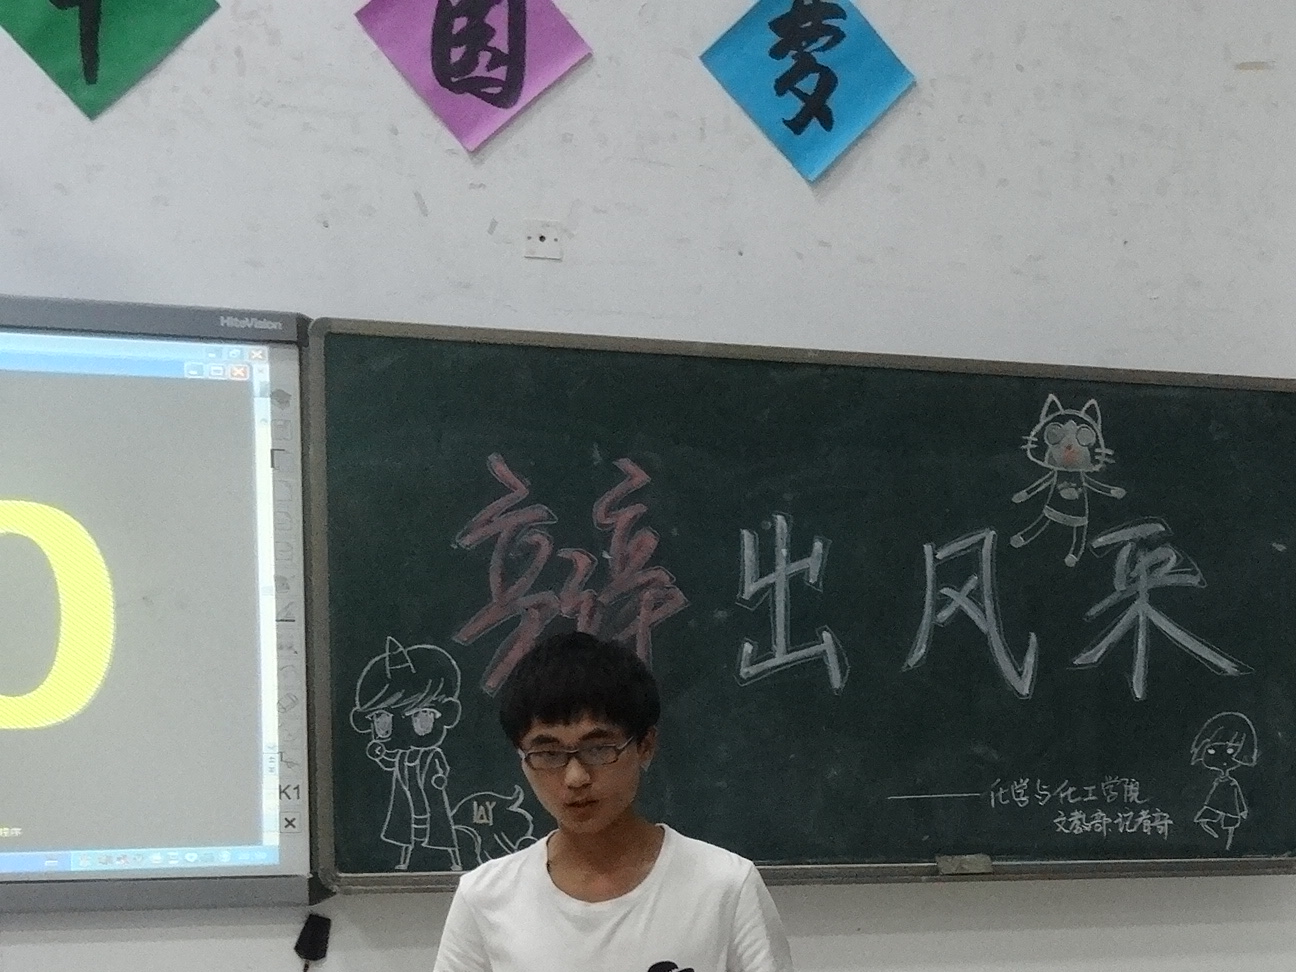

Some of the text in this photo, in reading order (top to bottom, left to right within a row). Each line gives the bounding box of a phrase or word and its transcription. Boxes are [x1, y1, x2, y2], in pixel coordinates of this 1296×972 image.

[278, 784, 300, 800] K1
[990, 776, 1150, 808] 化学与化工学院
